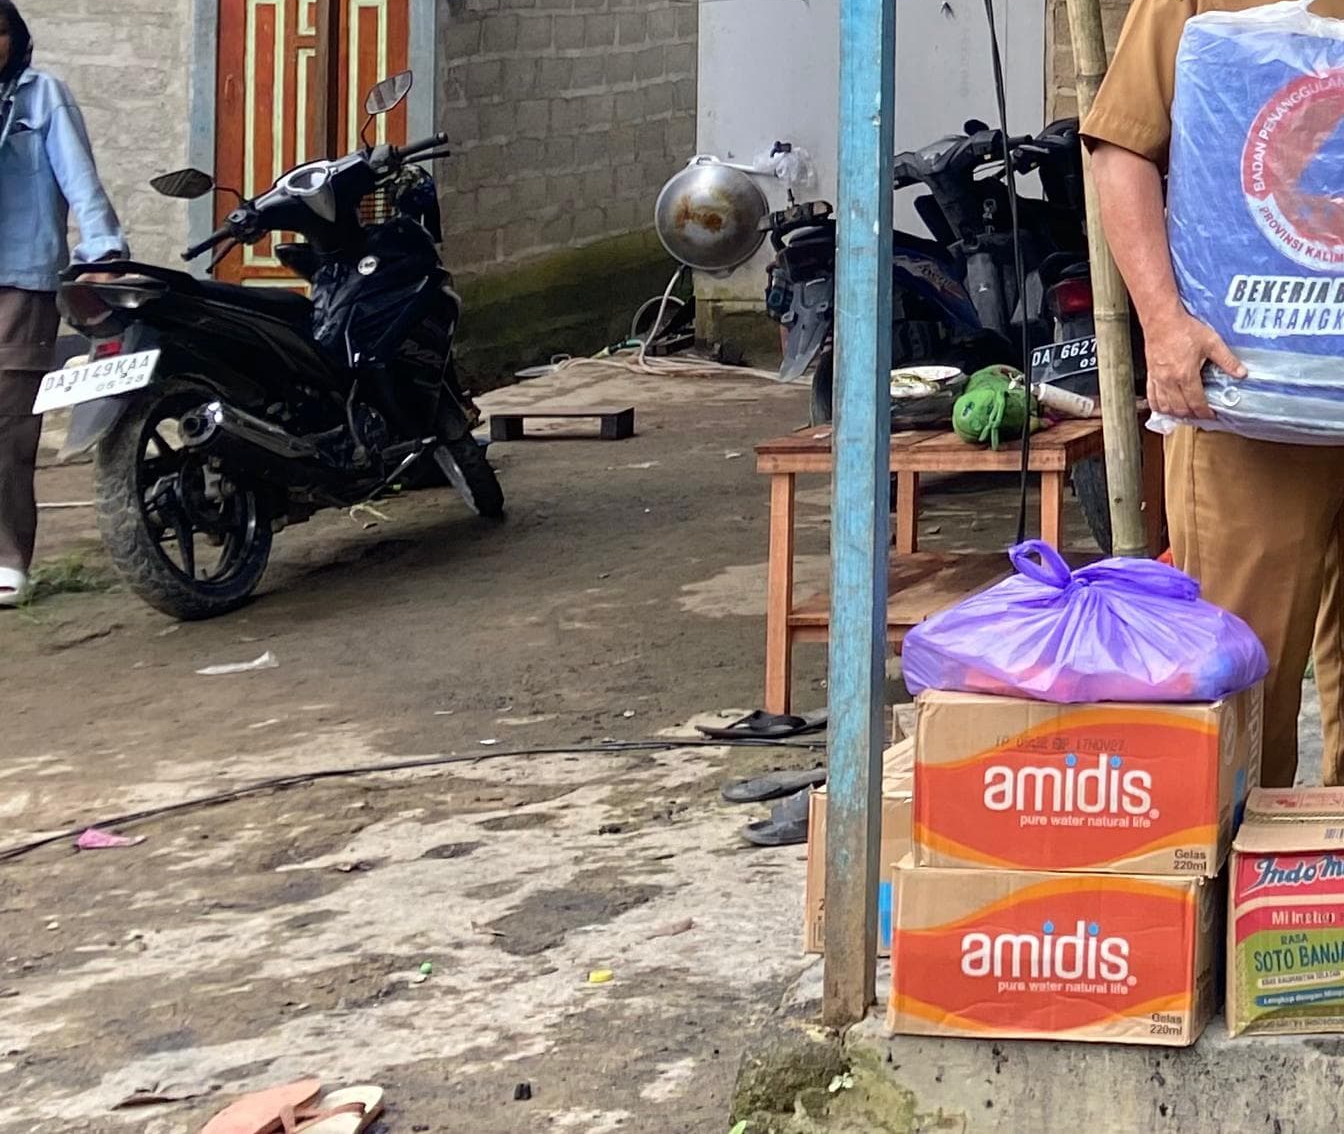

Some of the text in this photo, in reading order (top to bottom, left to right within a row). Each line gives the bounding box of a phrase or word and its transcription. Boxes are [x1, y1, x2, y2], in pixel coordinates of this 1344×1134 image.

[1252, 142, 1266, 192] BADAN
[1259, 206, 1304, 252] PROVINSI
[1232, 279, 1331, 303] BEKERJA
[1032, 338, 1097, 366] DA 6627
[44, 375, 65, 392] DA
[983, 752, 1153, 815] amidis
[1020, 815, 1151, 829] pure water natural life
[1174, 849, 1207, 860] Gelas
[1173, 860, 1208, 871] 220ml
[1271, 911, 1289, 925] Mi
[1280, 933, 1309, 945] RASA
[961, 920, 1130, 982] amidis
[1254, 949, 1295, 972] SOTO
[998, 981, 1129, 995] pure water natural life
[1150, 1024, 1183, 1036] 220ml
